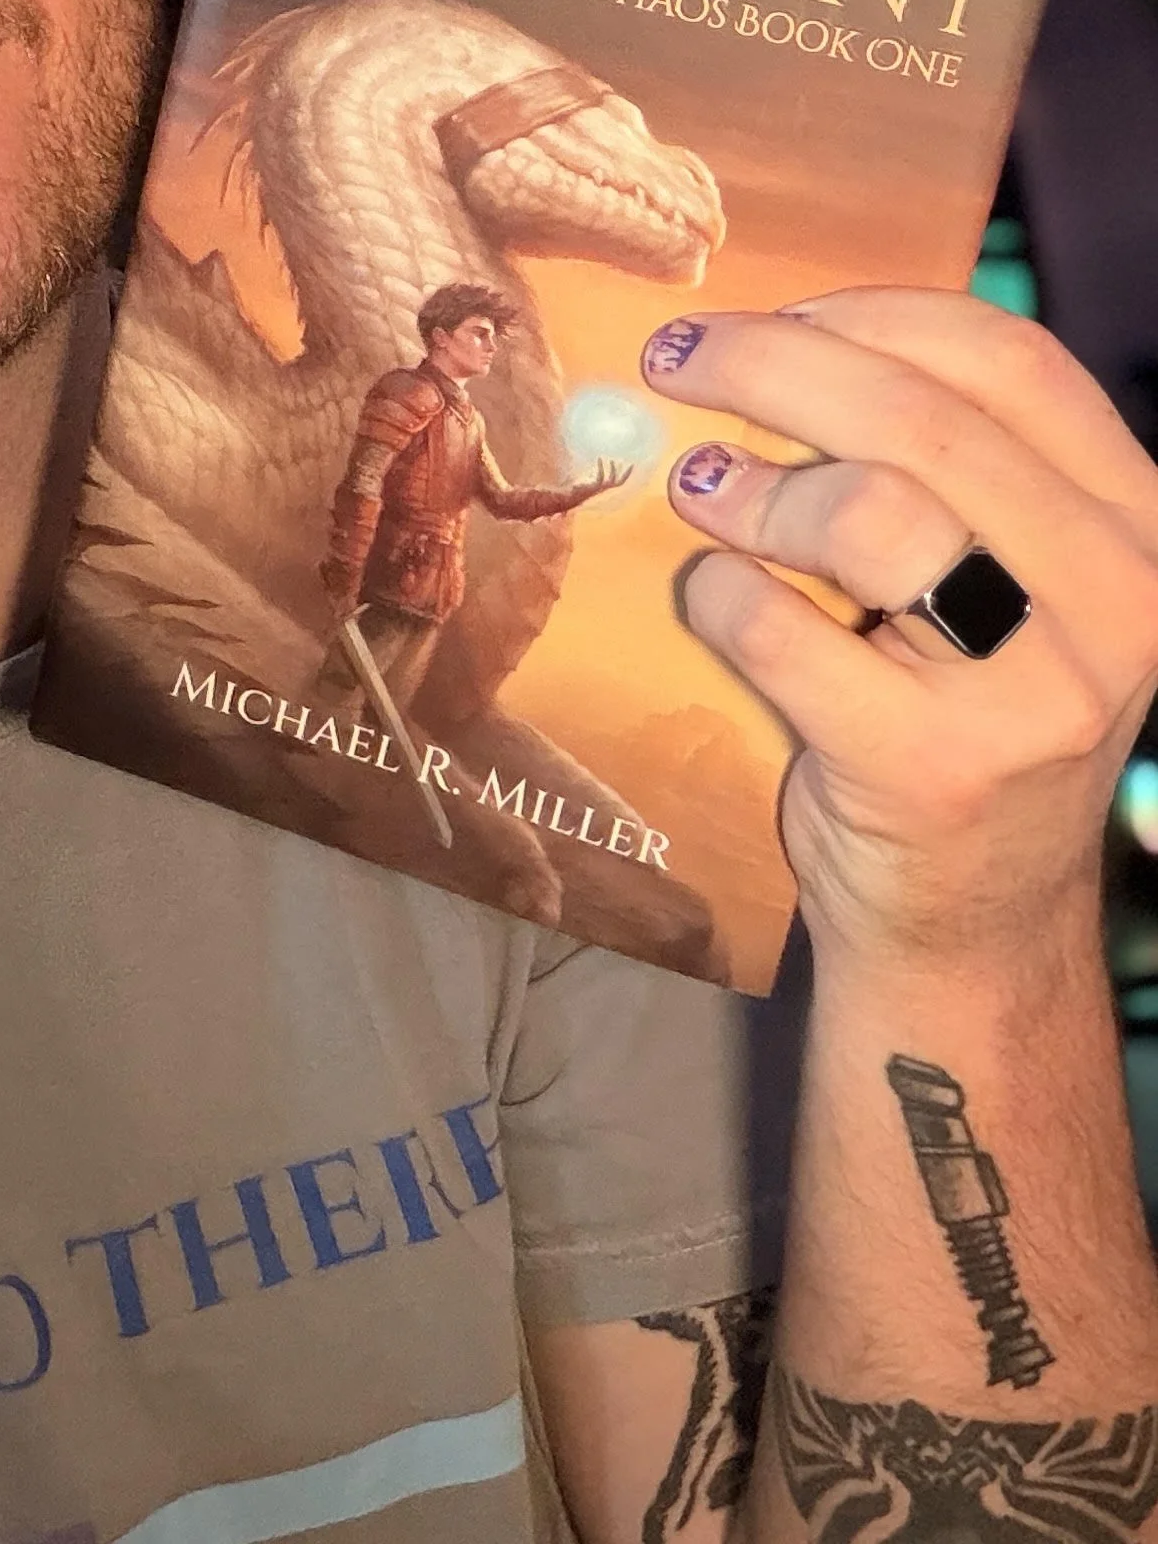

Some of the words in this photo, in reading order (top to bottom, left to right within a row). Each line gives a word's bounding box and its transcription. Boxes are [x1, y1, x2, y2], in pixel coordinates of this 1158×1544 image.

[736, 6, 859, 64] BOOK
[865, 38, 964, 88] ONE
[170, 661, 400, 774] MICHAEL
[417, 744, 461, 796] R.
[476, 767, 671, 870] MILLER
